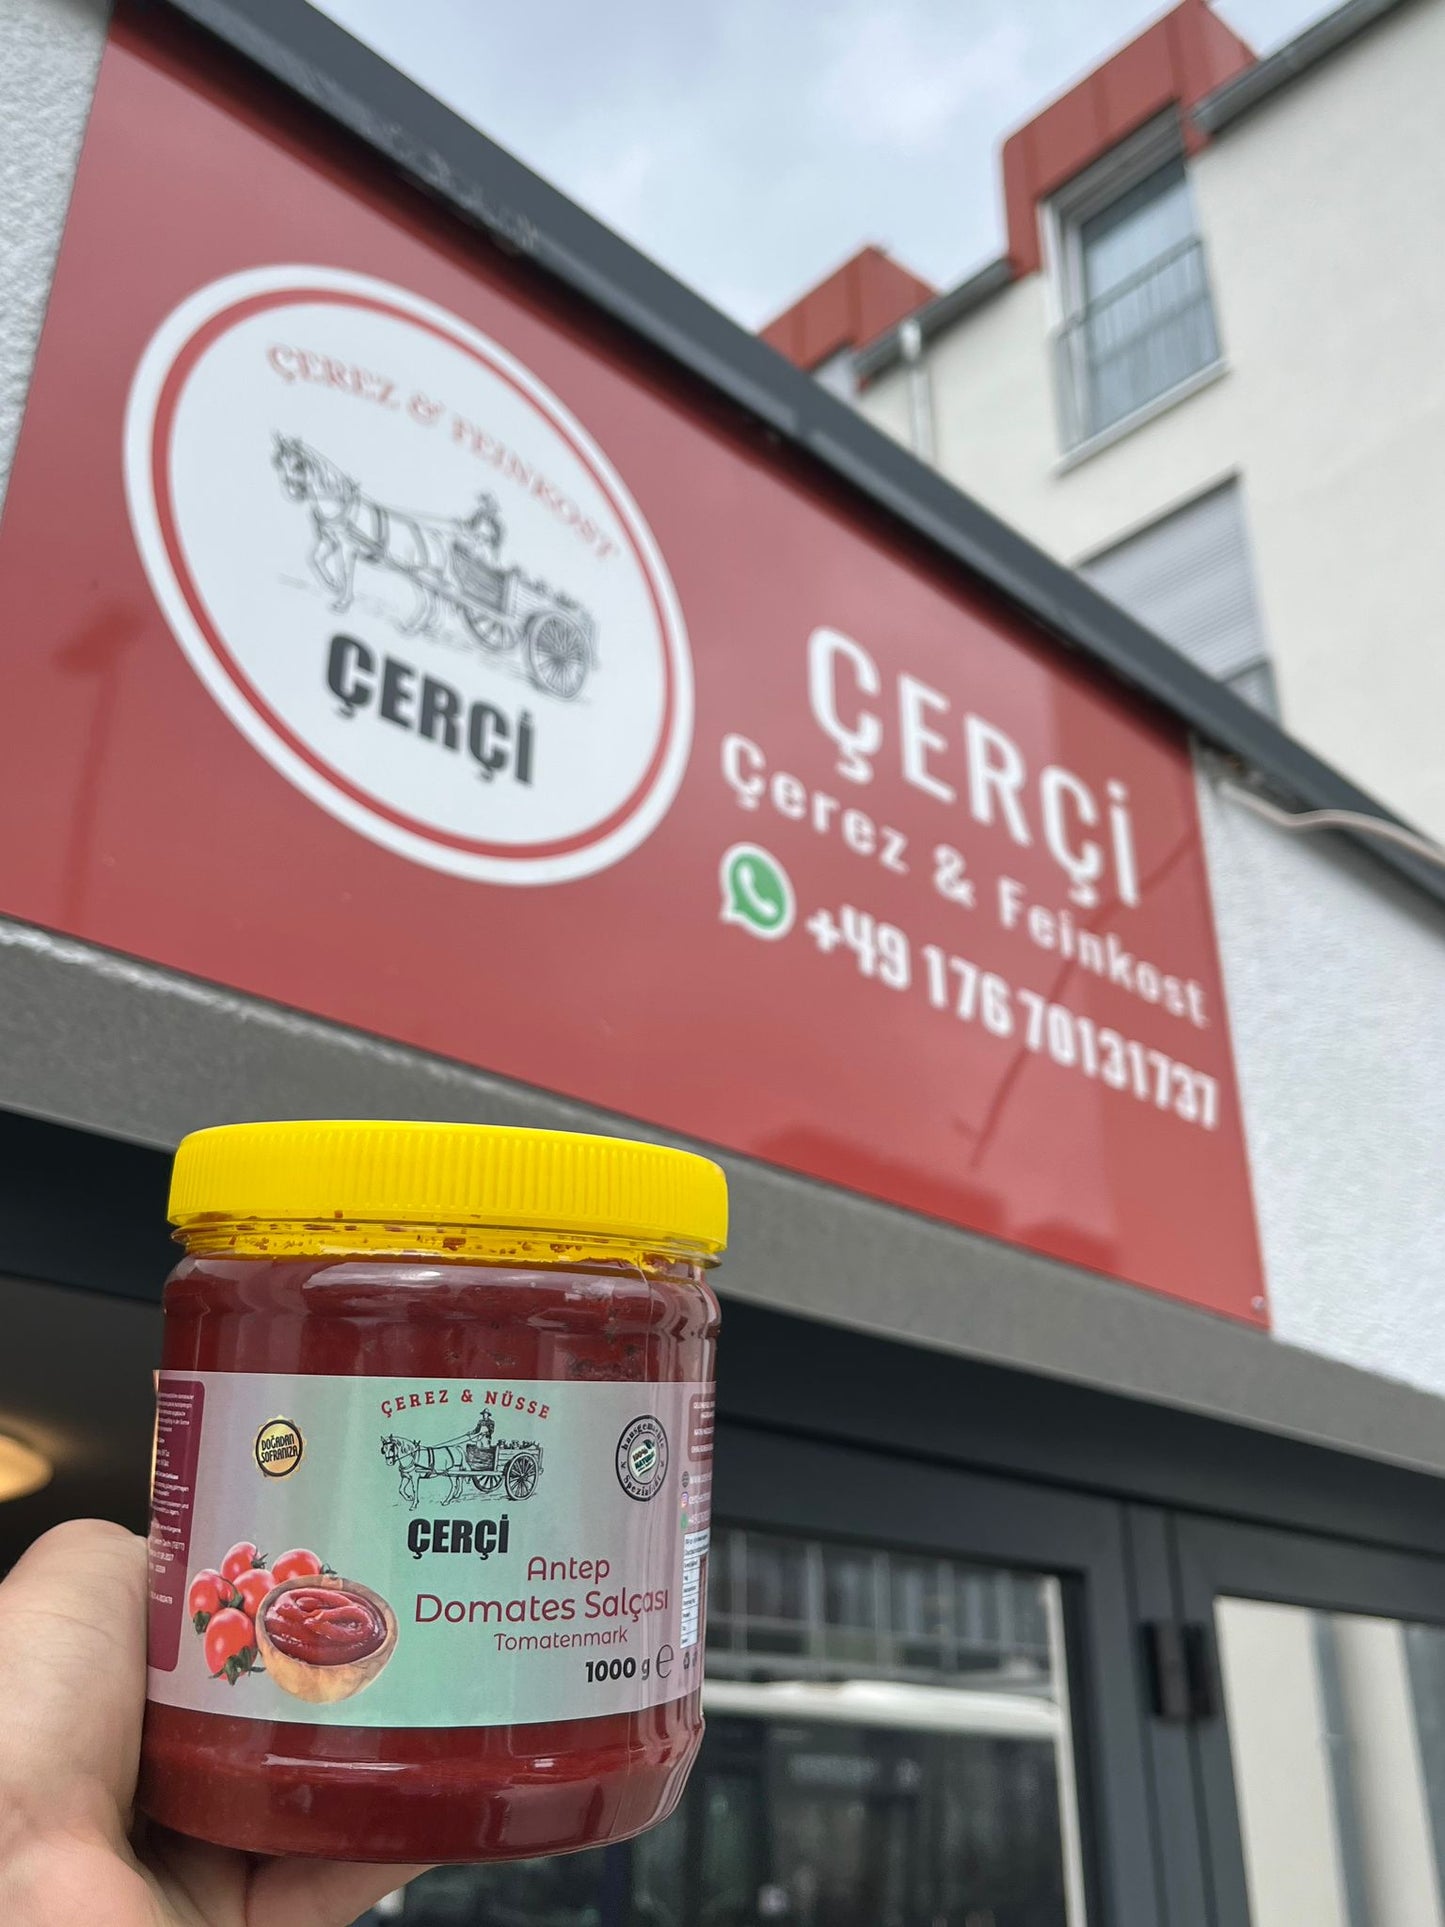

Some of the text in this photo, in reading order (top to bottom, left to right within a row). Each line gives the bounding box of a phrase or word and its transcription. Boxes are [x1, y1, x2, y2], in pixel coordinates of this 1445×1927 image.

[407, 393, 443, 428] &
[452, 418, 618, 560] FEINKOST
[326, 632, 534, 787] ÇERÇİ
[808, 628, 1139, 907] ÇERÇİ
[721, 733, 1210, 1030] Çerez & Feinkost
[806, 903, 1219, 1131] +49 176 70131737
[381, 1389, 550, 1419] ÇEREZ & NÜSSE
[407, 1514, 510, 1560] ÇERÇİ
[527, 1556, 610, 1584] Antep
[415, 1587, 669, 1623] Domates Salçası
[494, 1626, 628, 1651] Tomatenmark
[585, 1657, 636, 1683] 1000
[641, 1658, 651, 1681] g
